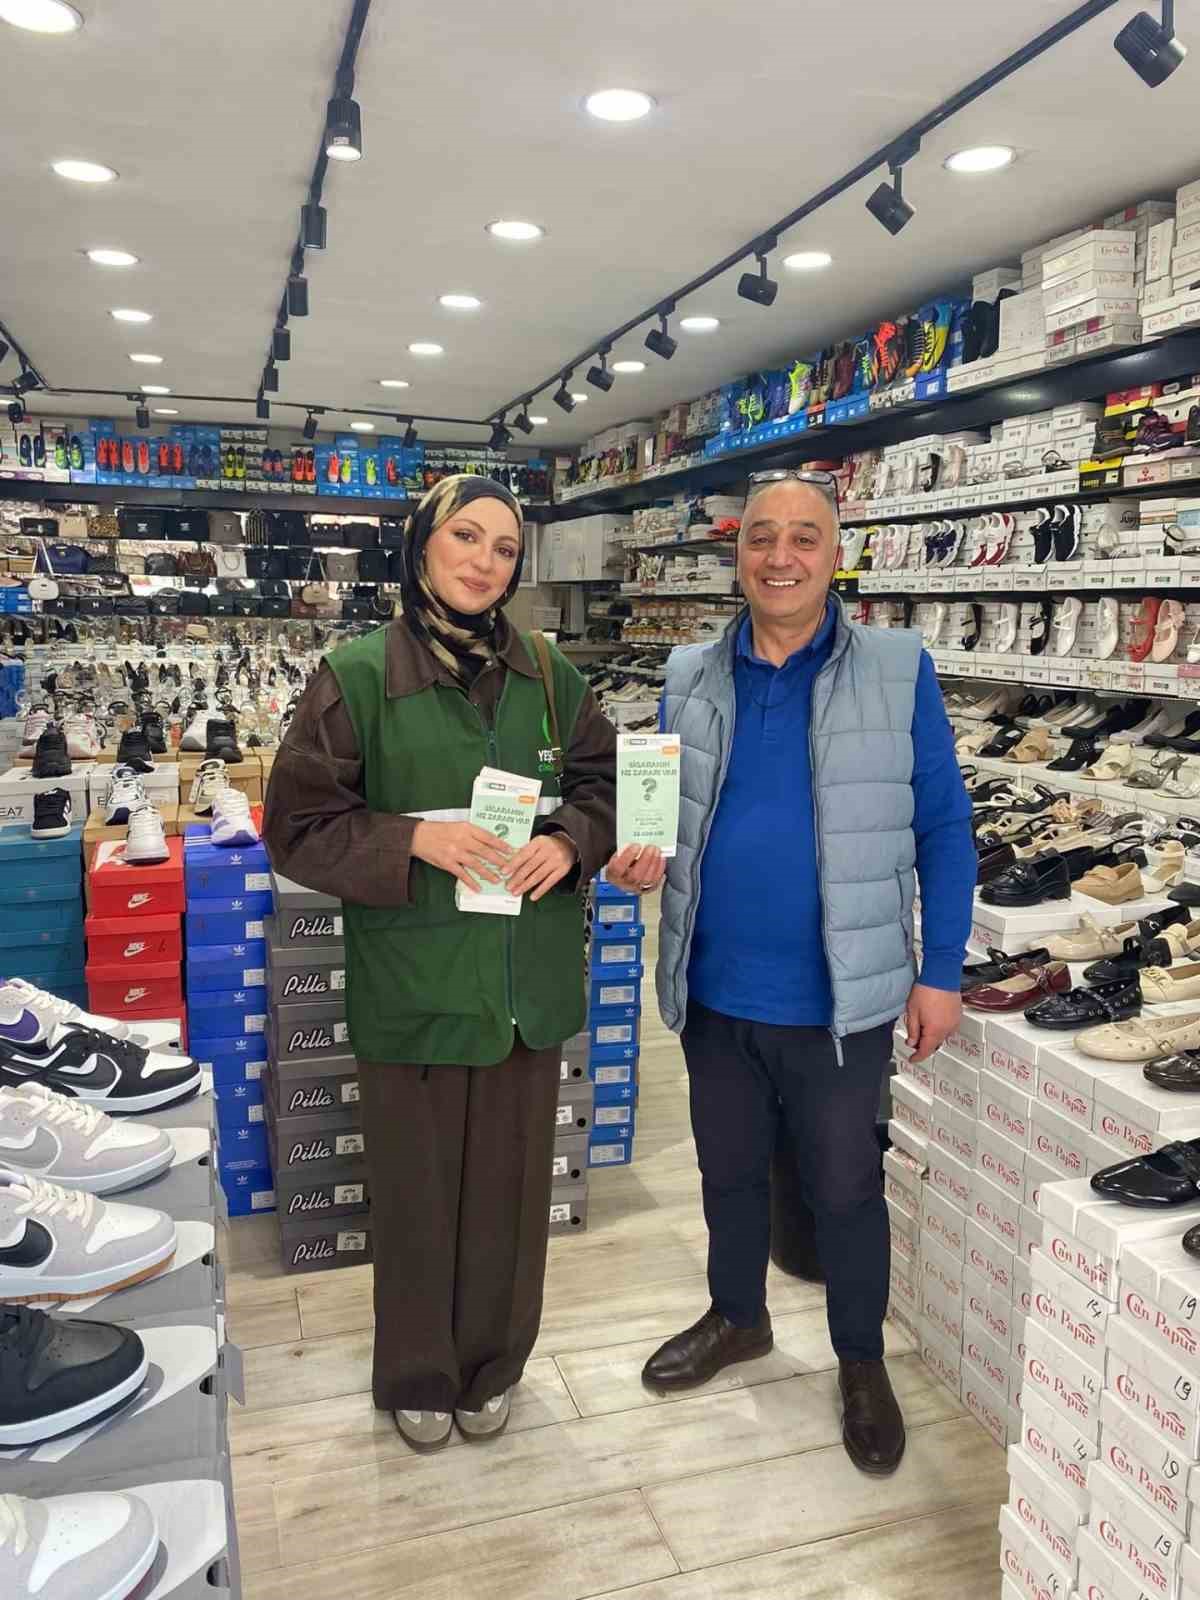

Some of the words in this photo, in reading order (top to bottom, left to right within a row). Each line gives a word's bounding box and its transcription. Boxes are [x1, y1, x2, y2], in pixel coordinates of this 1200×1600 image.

[289, 917, 334, 939] Pilla
[282, 974, 329, 997] Pilla
[287, 1028, 333, 1052] Pilla
[288, 1086, 334, 1111] Pilla
[288, 1140, 332, 1165] Pilla
[288, 1191, 332, 1216] Pilla
[293, 1239, 336, 1265] Pilla
[1052, 1238, 1073, 1263] Can
[1036, 1293, 1056, 1319] Can
[1127, 1293, 1149, 1320] Can
[1179, 1296, 1196, 1320] 19
[1029, 1359, 1050, 1385] Can
[1117, 1374, 1140, 1402] Can
[1174, 1376, 1192, 1401] 19
[1027, 1427, 1048, 1454] Can
[1073, 1438, 1087, 1460] 14
[1110, 1446, 1133, 1475] Can
[1162, 1451, 1180, 1479] 19
[1018, 1498, 1036, 1525] Can
[1099, 1520, 1123, 1550] Can
[1154, 1535, 1171, 1556] 19
[1005, 1549, 1022, 1576] Can
